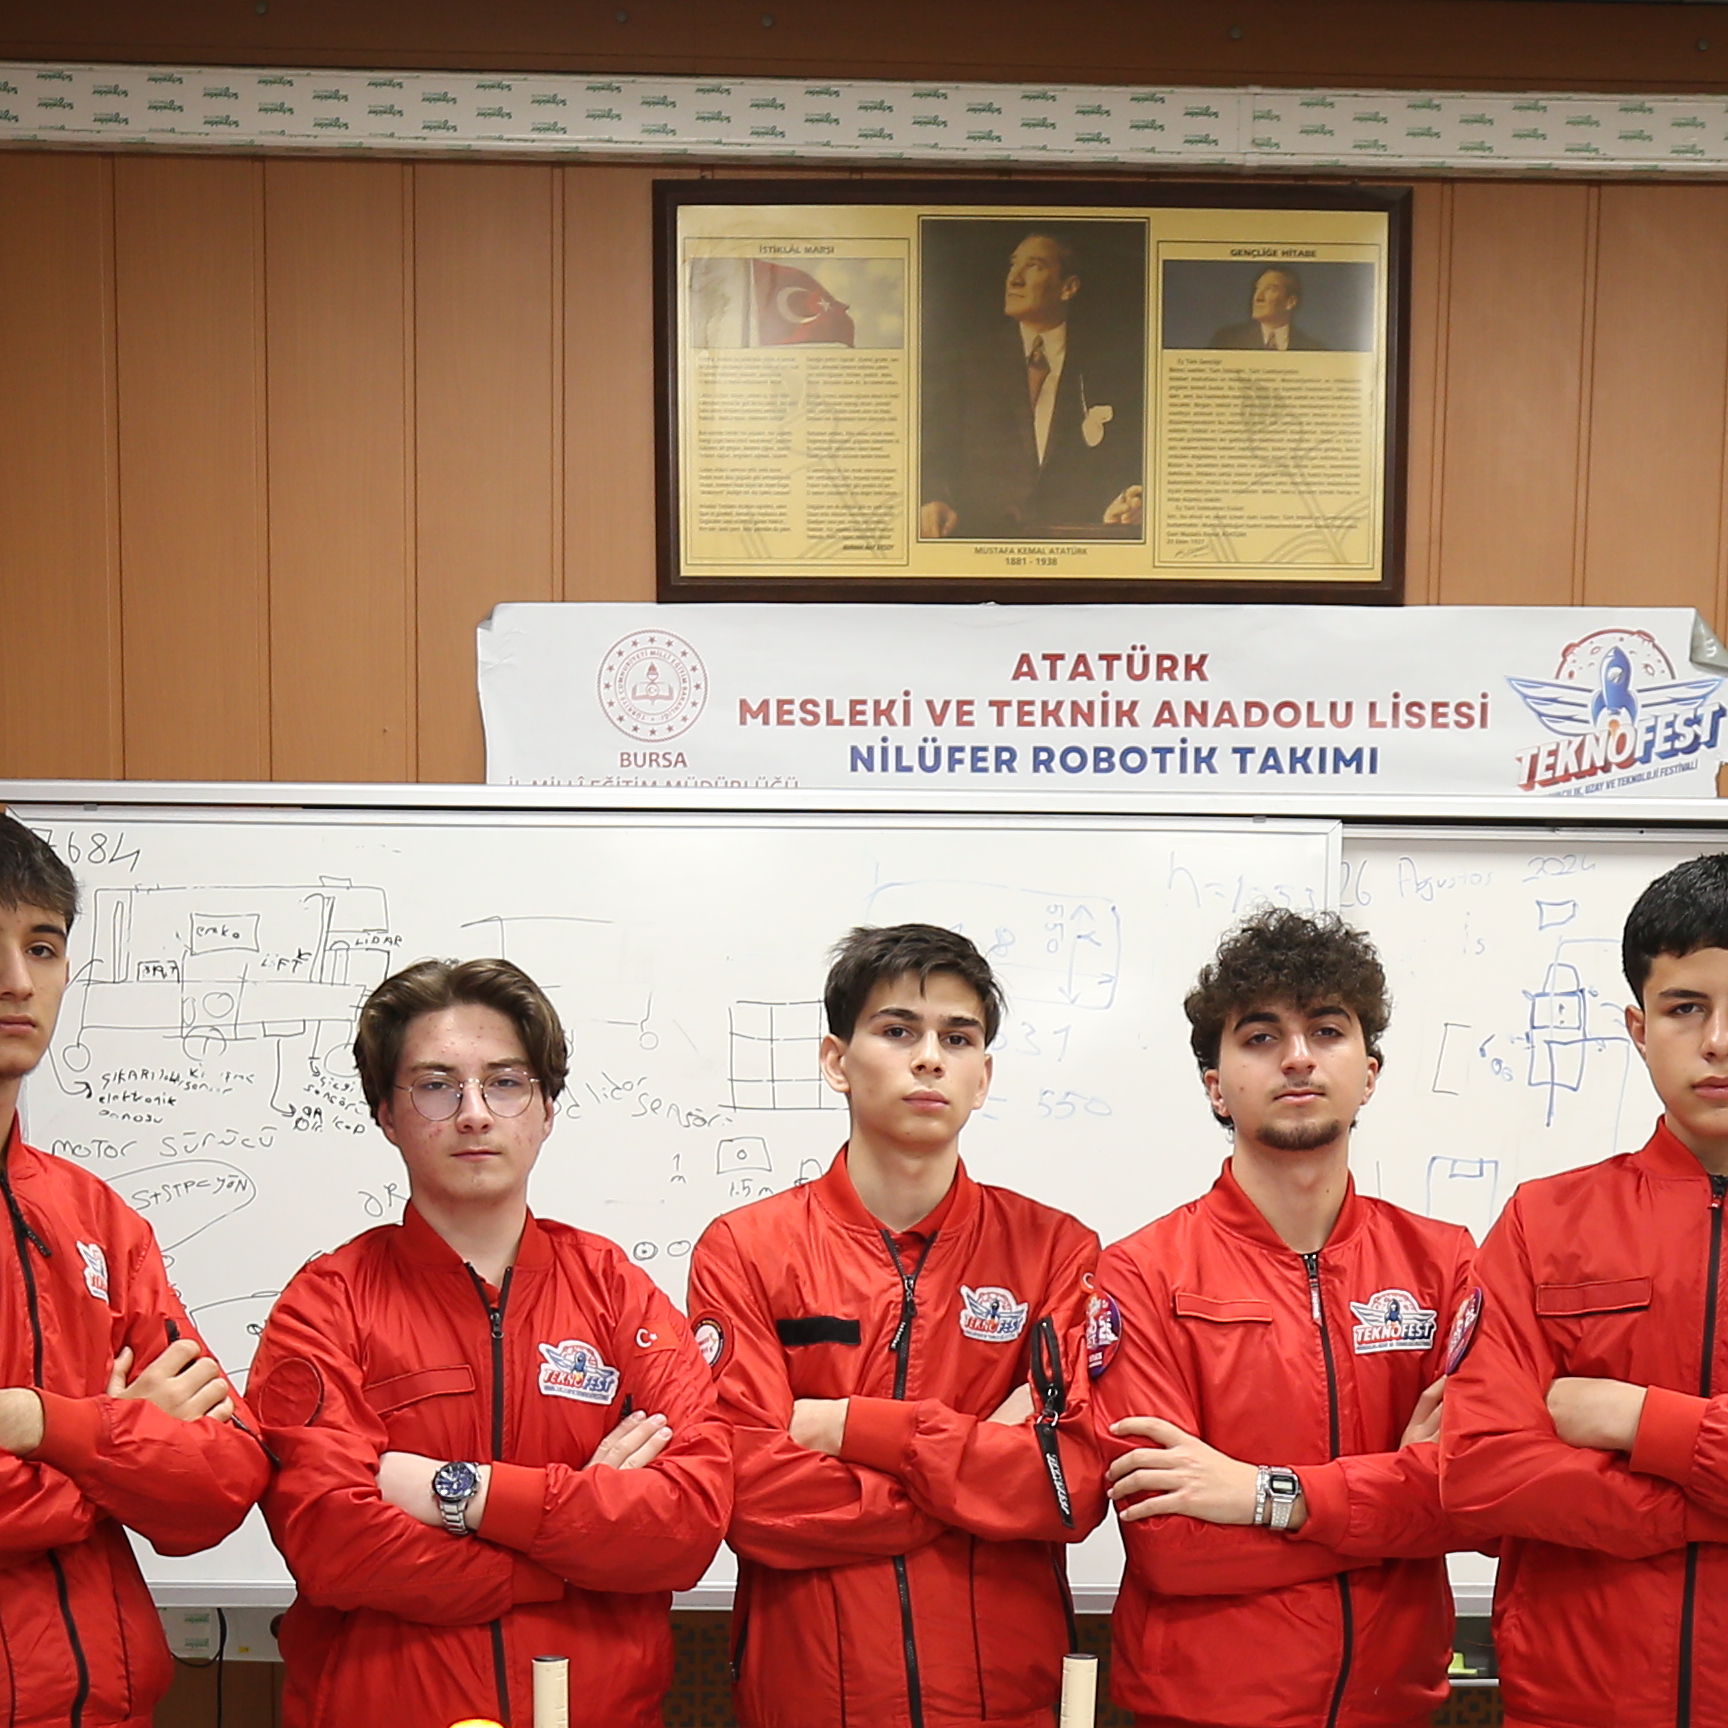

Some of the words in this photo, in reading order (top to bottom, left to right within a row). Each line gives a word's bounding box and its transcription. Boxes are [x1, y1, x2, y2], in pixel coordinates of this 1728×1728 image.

[974, 545, 1015, 556] MUSTAFA
[1017, 545, 1046, 556] KEMAL
[1005, 556, 1028, 567] 1881
[1035, 556, 1059, 567] 1938
[1011, 643, 1210, 683] ATATÜRK
[739, 689, 912, 728] MESLEKİ
[925, 698, 976, 728] VE
[988, 690, 1140, 729] TEKNİK
[1152, 700, 1353, 731] ANADOLU
[1368, 691, 1490, 731] LİSESİ
[849, 735, 1019, 775] NİLÜFER
[1032, 735, 1220, 775] ROBOTİK
[1231, 744, 1379, 776] TAKIMI
[1515, 702, 1728, 792] TEKNOFEST
[619, 751, 688, 769] BURSA
[1357, 1321, 1434, 1346] TEKNOFEST
[543, 1369, 616, 1393] TEKNOFEST
